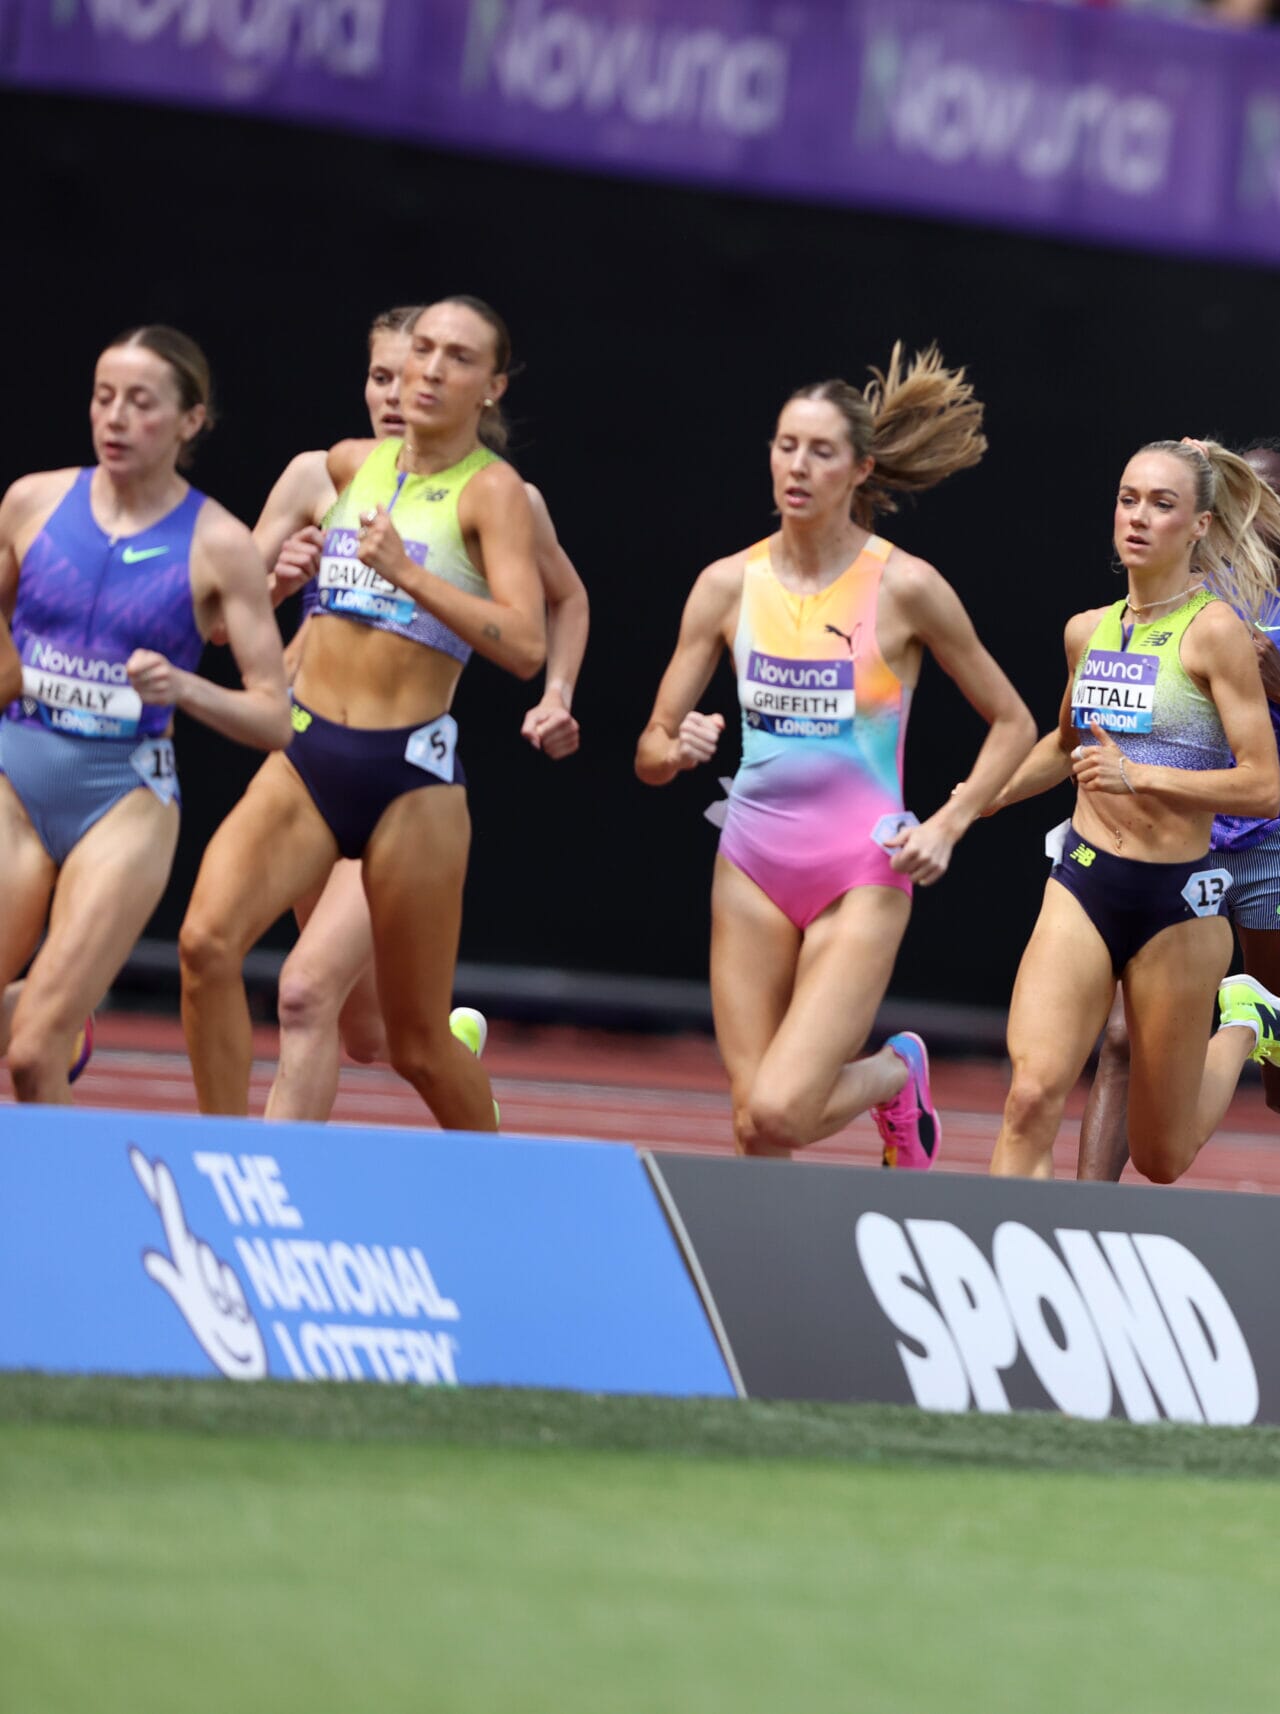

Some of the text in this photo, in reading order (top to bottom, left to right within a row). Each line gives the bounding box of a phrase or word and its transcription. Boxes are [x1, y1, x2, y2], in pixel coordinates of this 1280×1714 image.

[855, 27, 1172, 194] Novuna
[31, 640, 127, 683] Novuna
[754, 656, 838, 687] Novuna
[1082, 660, 1144, 681] ovuna
[38, 680, 113, 710] HEALY
[753, 690, 838, 713] GRIFFITH
[52, 709, 122, 736] LONDON
[775, 719, 839, 737] LONDON
[1083, 711, 1138, 729] LONDON
[430, 730, 447, 760] 5
[1197, 878, 1226, 908] 13
[193, 1151, 304, 1229] THE
[234, 1236, 461, 1321] NATIONAL
[856, 1211, 1260, 1428] SPOND
